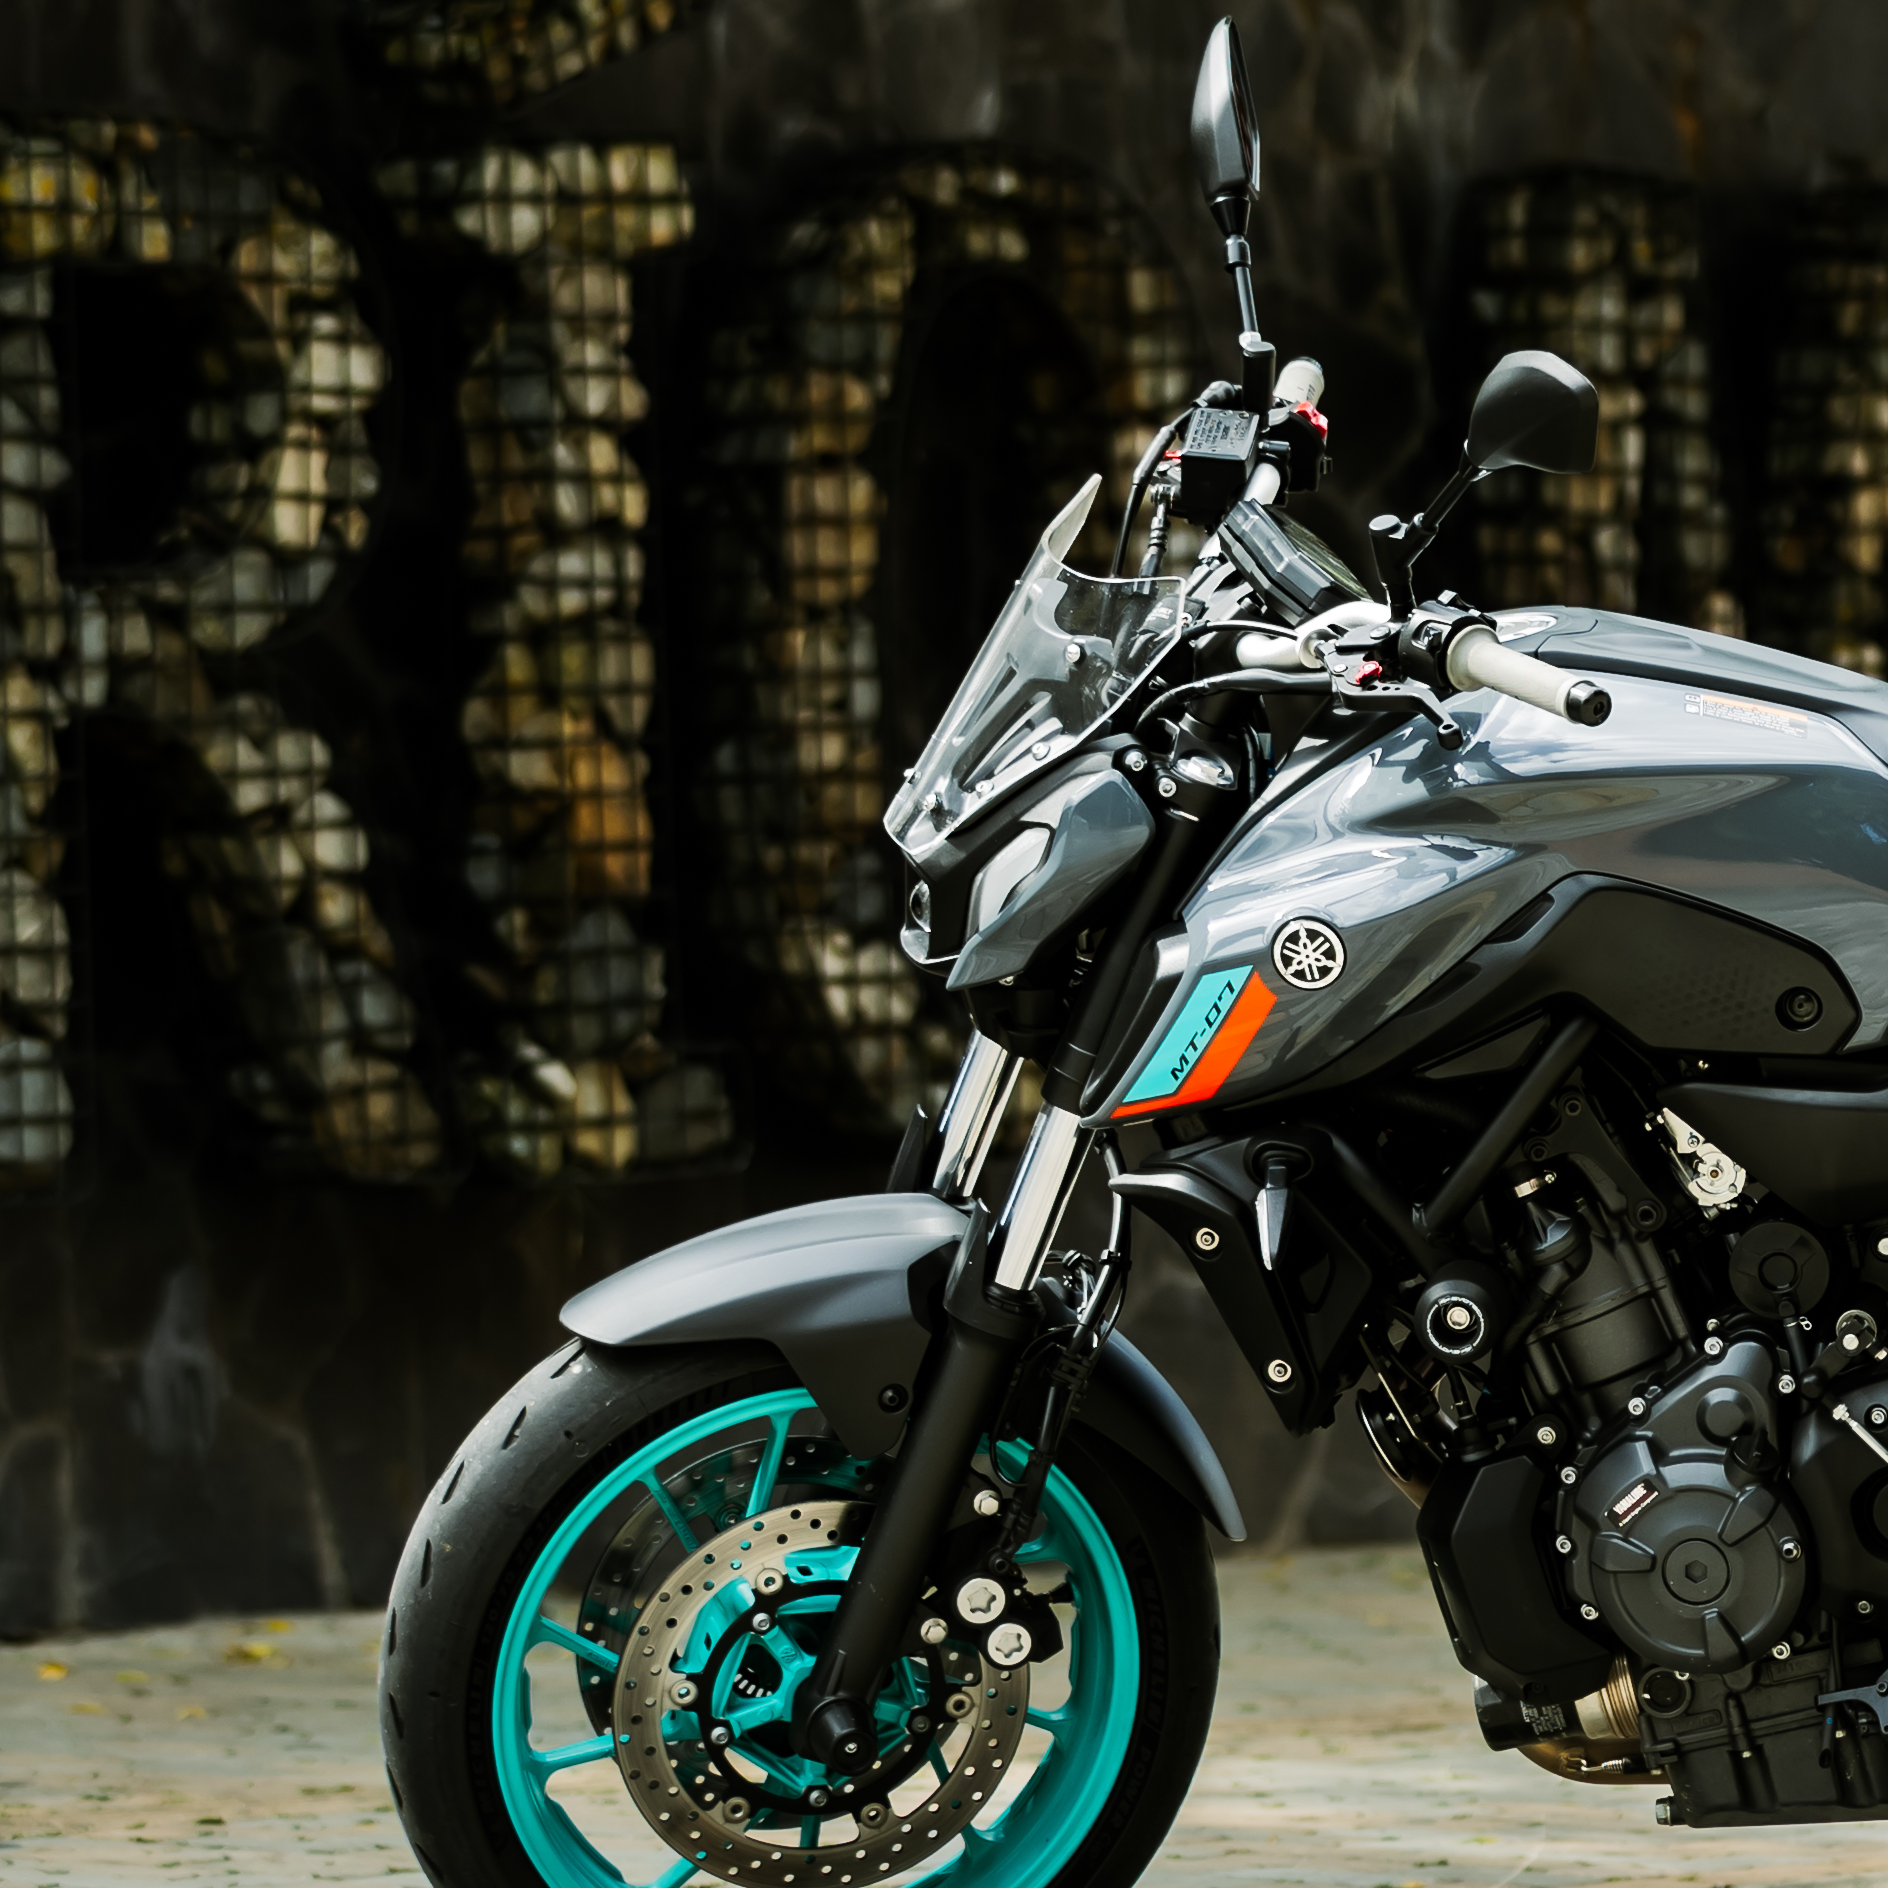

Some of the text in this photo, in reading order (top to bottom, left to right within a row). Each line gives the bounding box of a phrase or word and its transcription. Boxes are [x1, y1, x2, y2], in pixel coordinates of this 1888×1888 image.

[1170, 980, 1235, 1081] MT-07
[481, 1571, 516, 1646] 120/70
[1141, 1576, 1167, 1721] MICHELIN
[467, 1668, 497, 1815] MICHELIN
[1110, 1744, 1153, 1830] POWER
